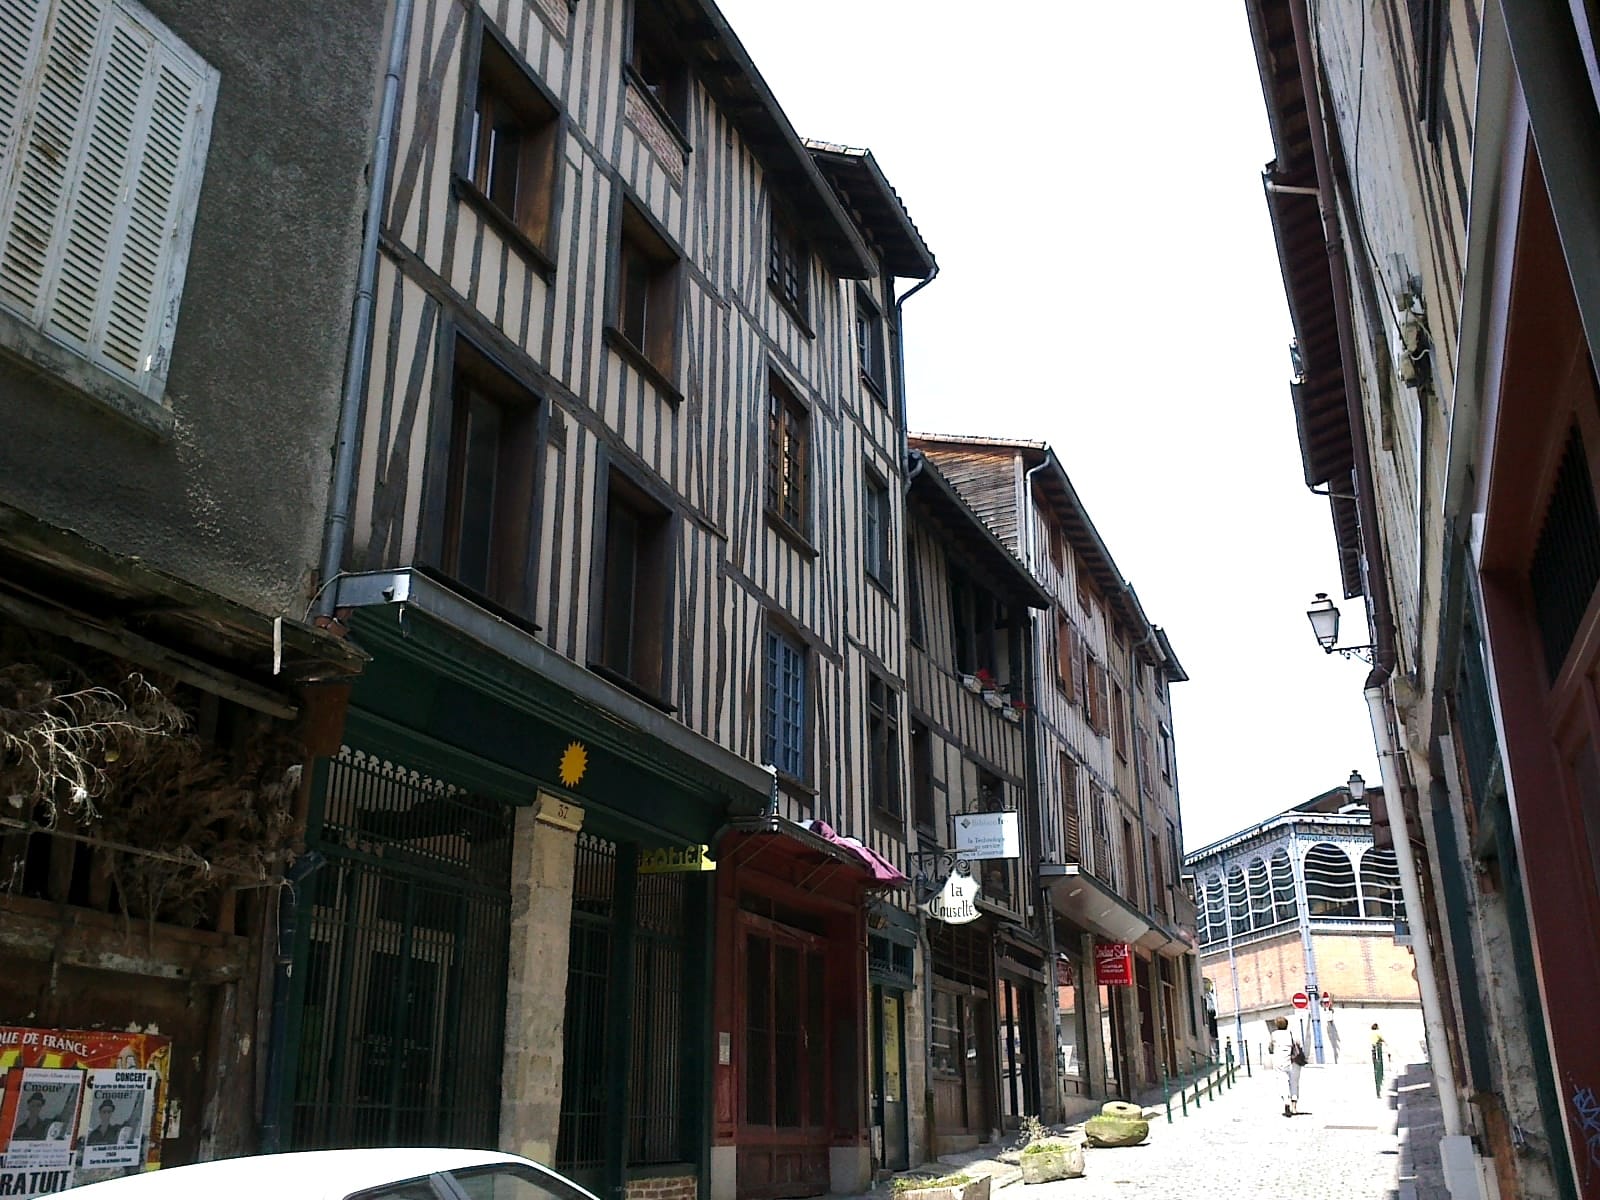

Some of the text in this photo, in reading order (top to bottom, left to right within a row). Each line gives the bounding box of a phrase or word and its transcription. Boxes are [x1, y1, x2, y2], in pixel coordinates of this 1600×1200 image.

[557, 804, 569, 820] 37
[951, 883, 963, 897] la
[0, 1032, 89, 1057] UE DE FRANCE
[115, 1072, 147, 1082] CONCERT
